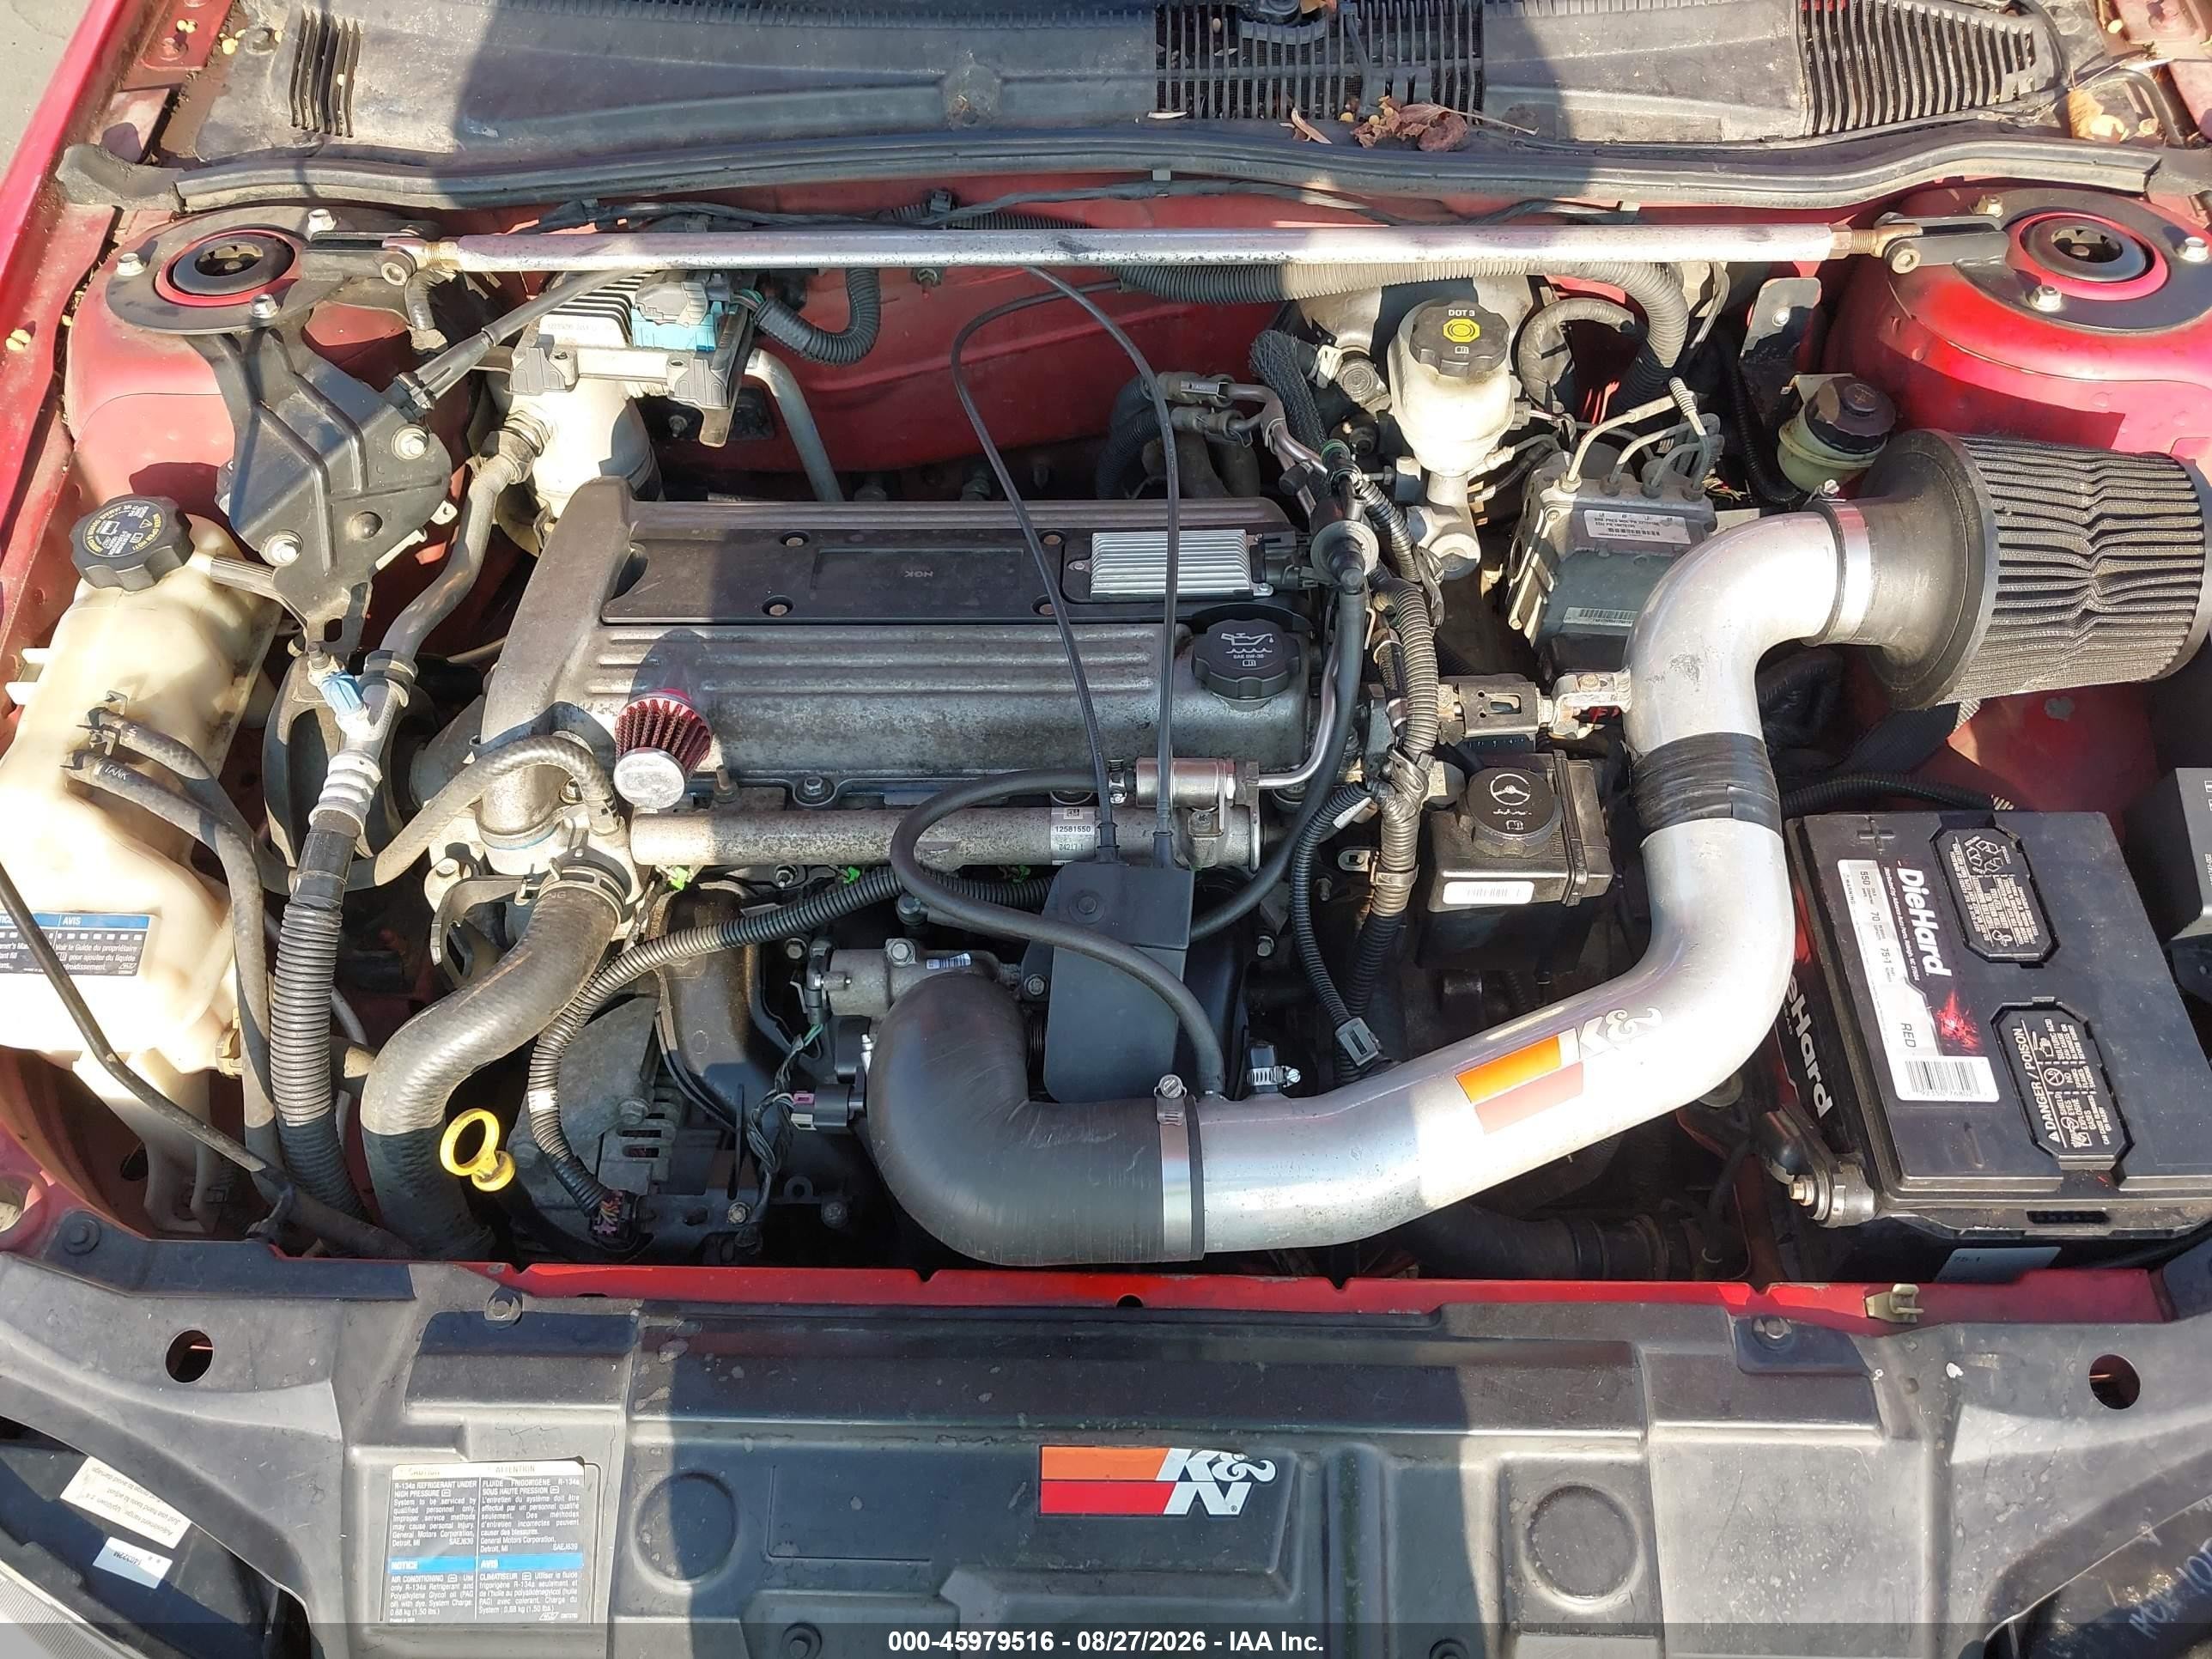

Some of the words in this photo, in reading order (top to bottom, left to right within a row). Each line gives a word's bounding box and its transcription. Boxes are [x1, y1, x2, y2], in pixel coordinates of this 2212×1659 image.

[63, 916, 81, 926] AVIS
[1872, 912, 1880, 921] 70
[1896, 867, 1953, 976] DieHard
[1901, 1023, 1917, 1048] RED
[2013, 1028, 2036, 1070] POISON
[2064, 1073, 2074, 1083] NO
[2031, 1080, 2057, 1130] DANGER
[2055, 1092, 2067, 1115] SHIELD
[2064, 1100, 2075, 1115] EYES
[2084, 1110, 2096, 1130] GASES
[481, 1559, 498, 1569] AVIS
[480, 1572, 517, 1581] CLIMATISEUR
